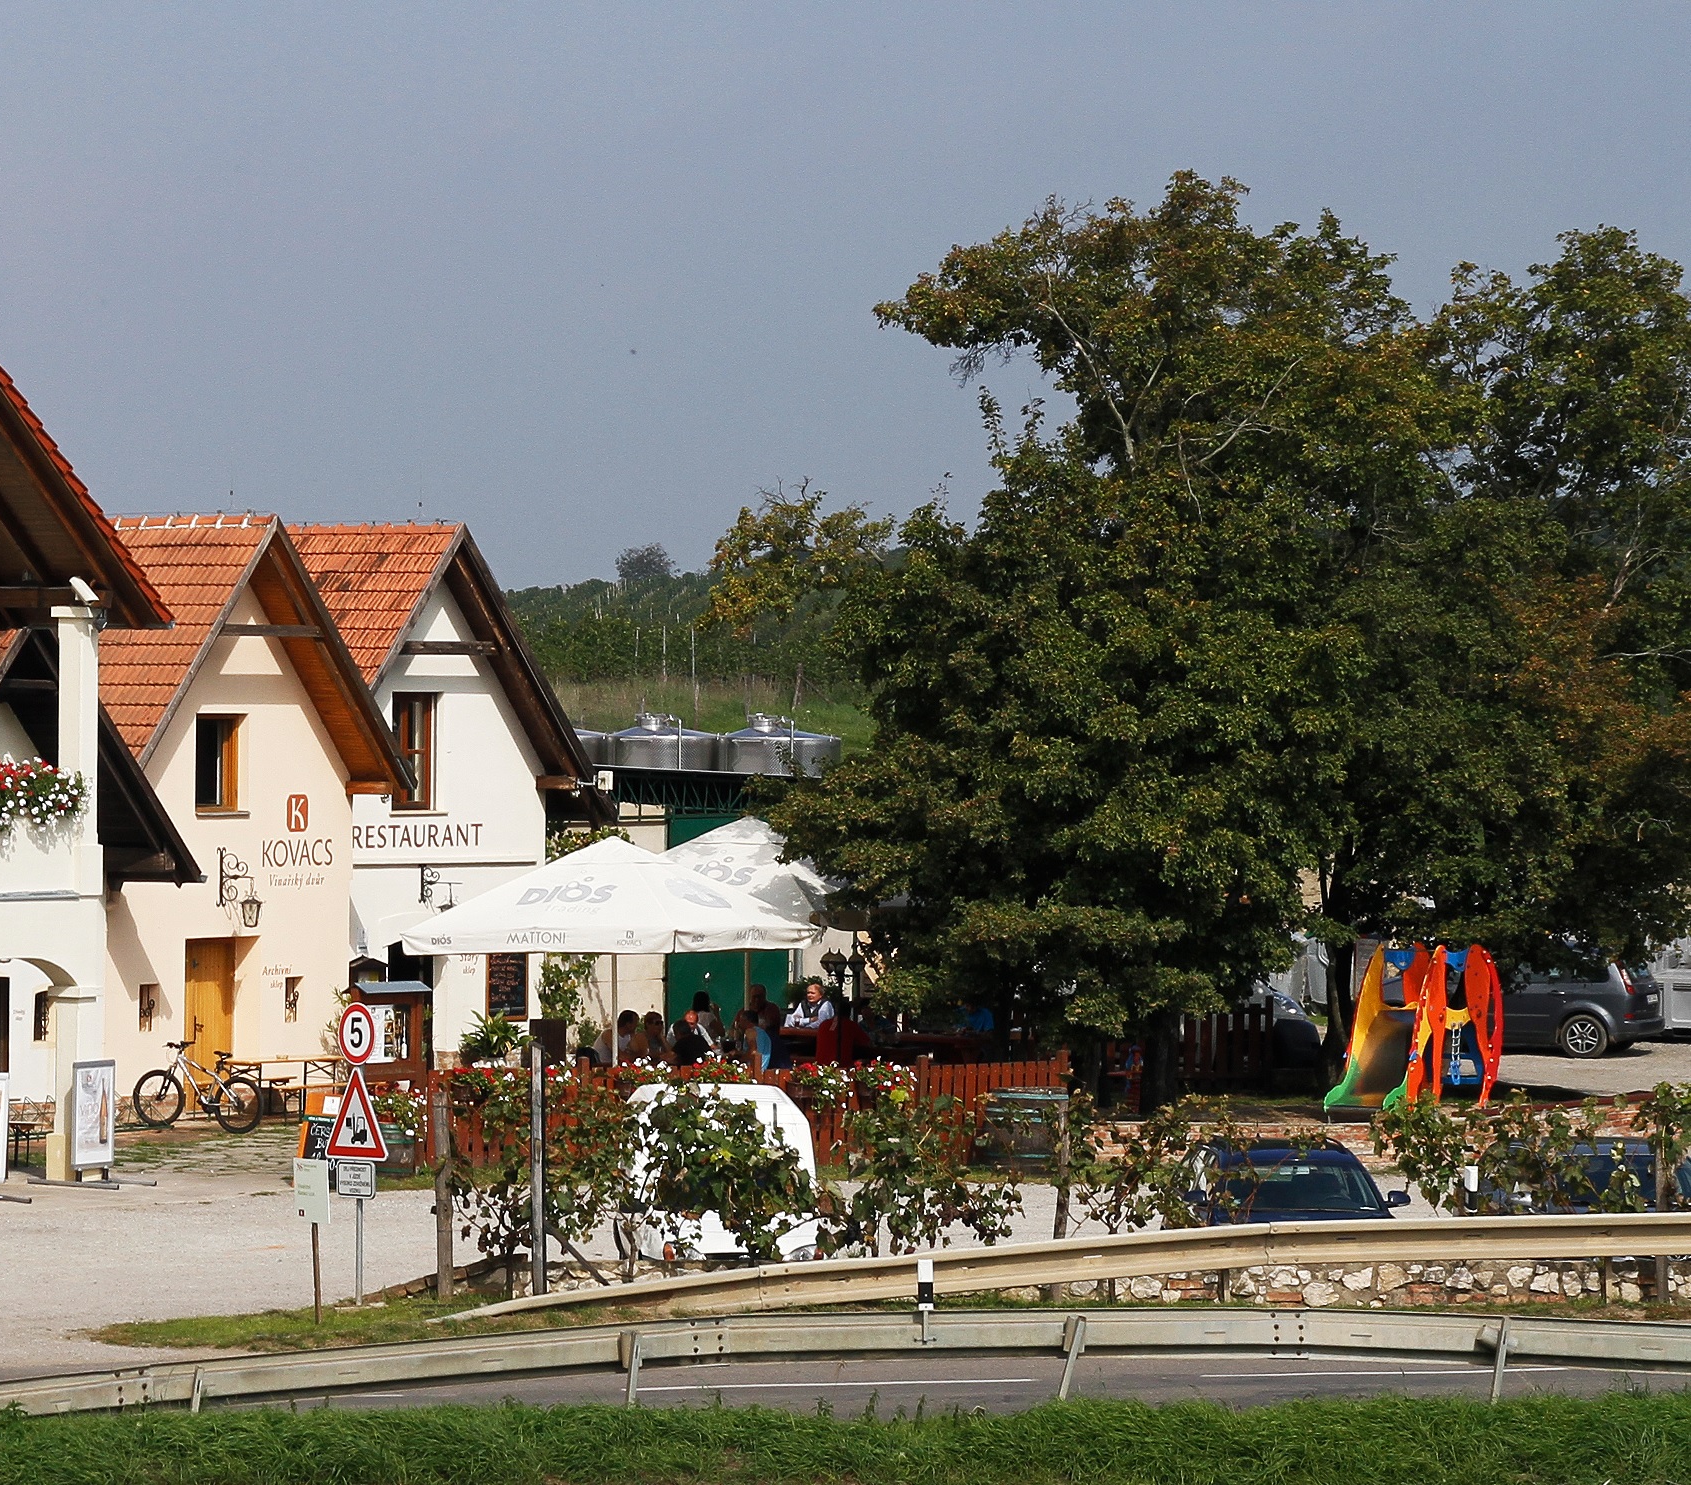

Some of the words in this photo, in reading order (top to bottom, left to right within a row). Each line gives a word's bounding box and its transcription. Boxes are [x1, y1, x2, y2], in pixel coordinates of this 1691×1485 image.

[351, 823, 484, 849] RESTAURANT
[261, 838, 333, 868] KOVACS
[268, 873, 305, 890] Vinařský
[305, 872, 325, 886] dvůr
[544, 903, 602, 916] trading
[506, 932, 566, 945] MATTONI
[616, 939, 642, 947] KOVACS
[349, 1016, 363, 1049] 5
